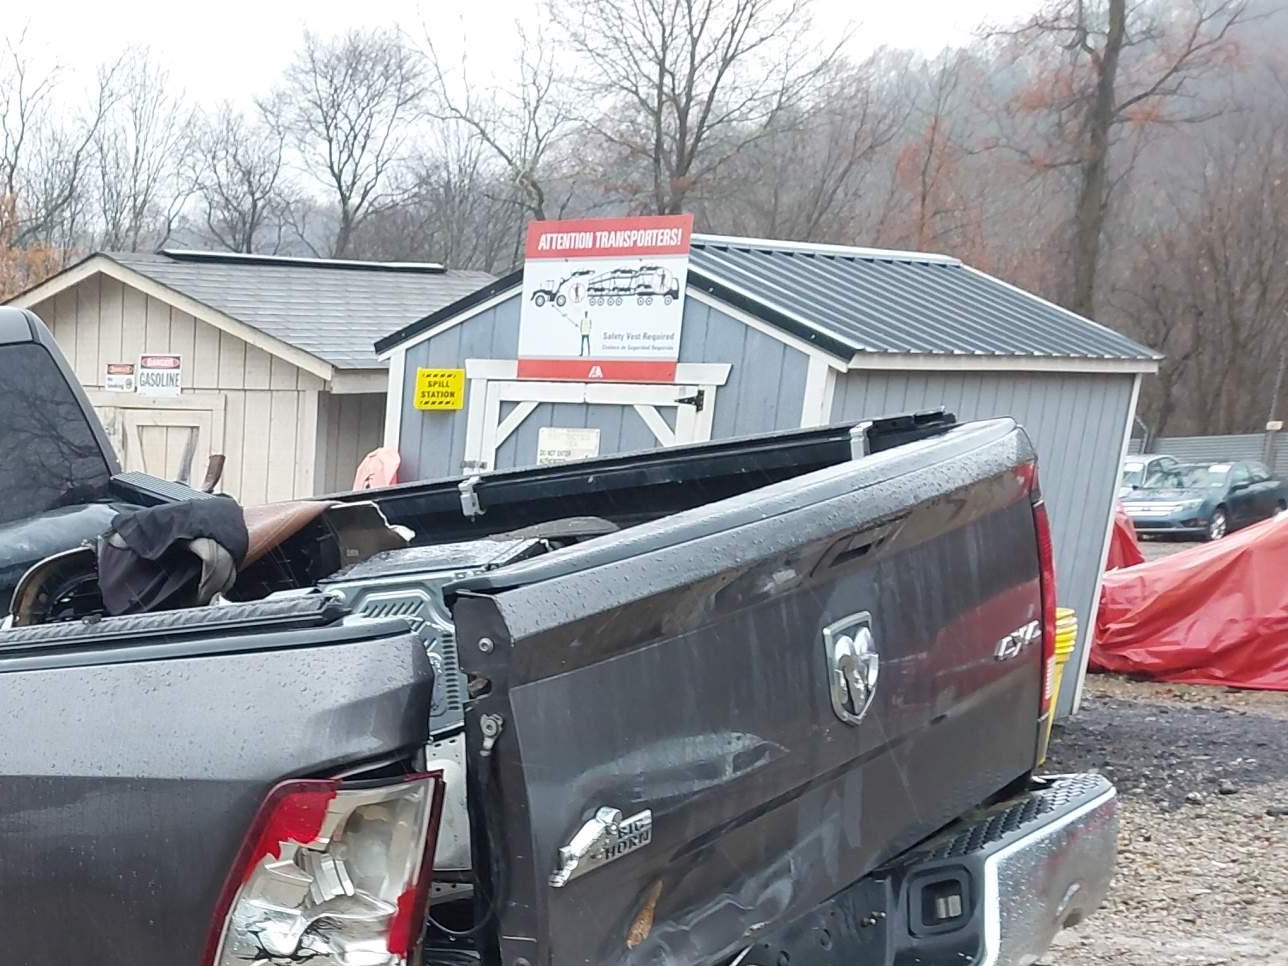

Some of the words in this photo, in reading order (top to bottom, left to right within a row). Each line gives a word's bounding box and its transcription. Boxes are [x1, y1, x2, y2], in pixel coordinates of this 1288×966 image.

[538, 231, 593, 251] ATTENTION
[595, 228, 683, 248] TRANSPORTERS!
[140, 372, 180, 387] GASOLINE
[427, 380, 450, 388] SPILL
[420, 390, 456, 399] STATION
[604, 830, 650, 860] HORN
